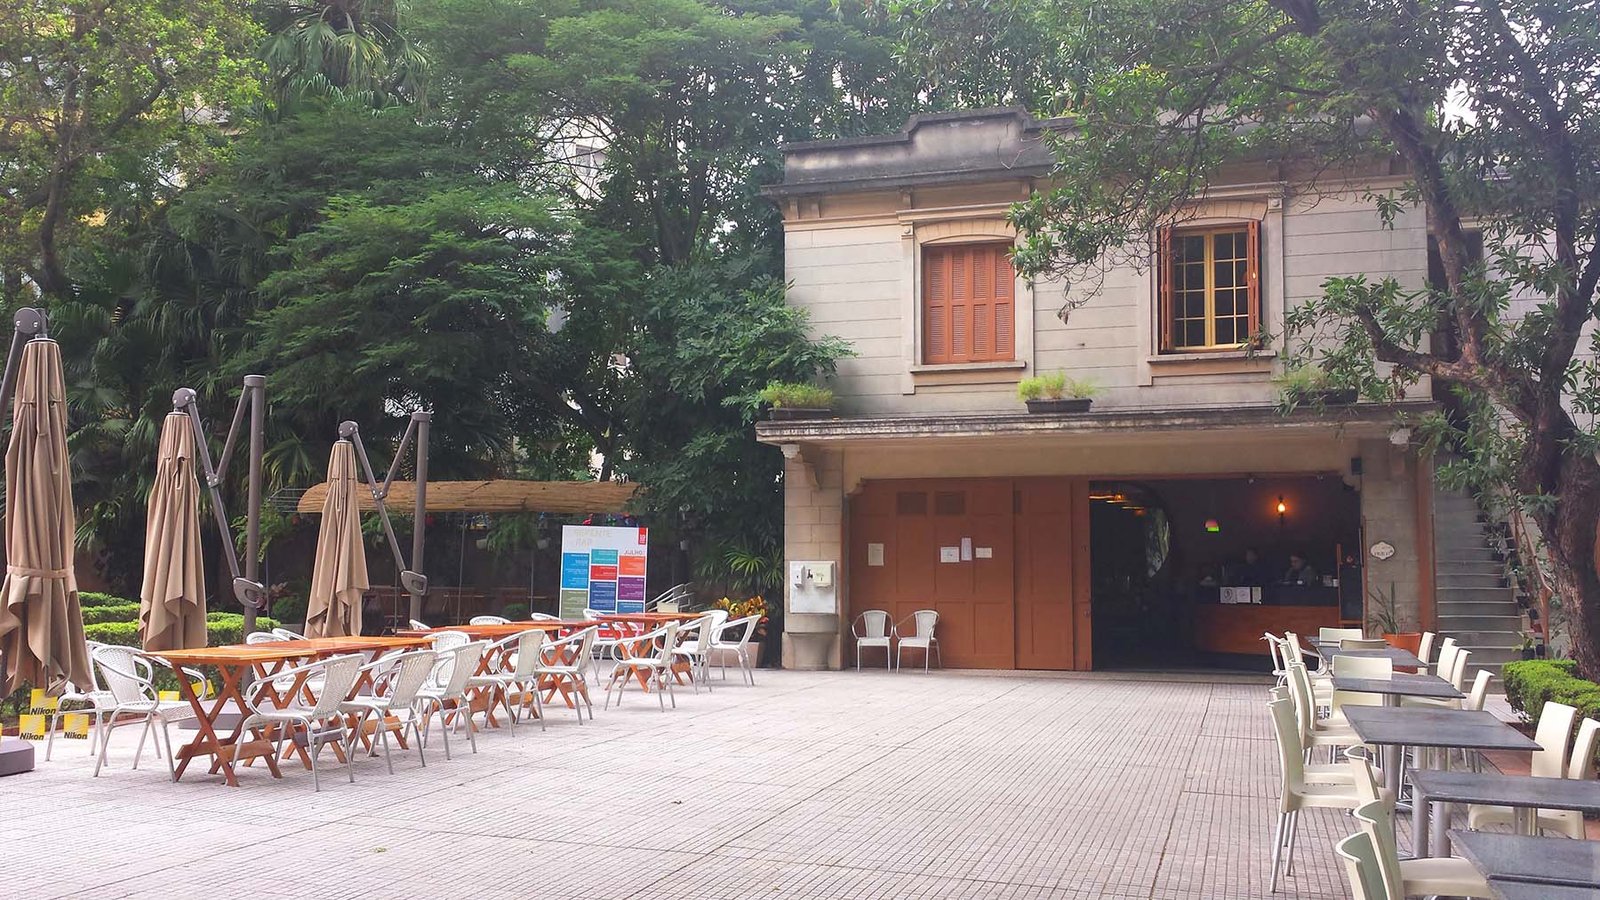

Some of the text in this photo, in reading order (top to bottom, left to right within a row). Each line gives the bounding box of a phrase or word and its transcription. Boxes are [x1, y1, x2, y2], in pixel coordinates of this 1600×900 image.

[31, 707, 57, 716] Nikon
[19, 732, 44, 741] Nikon
[64, 732, 88, 740] Nikon
